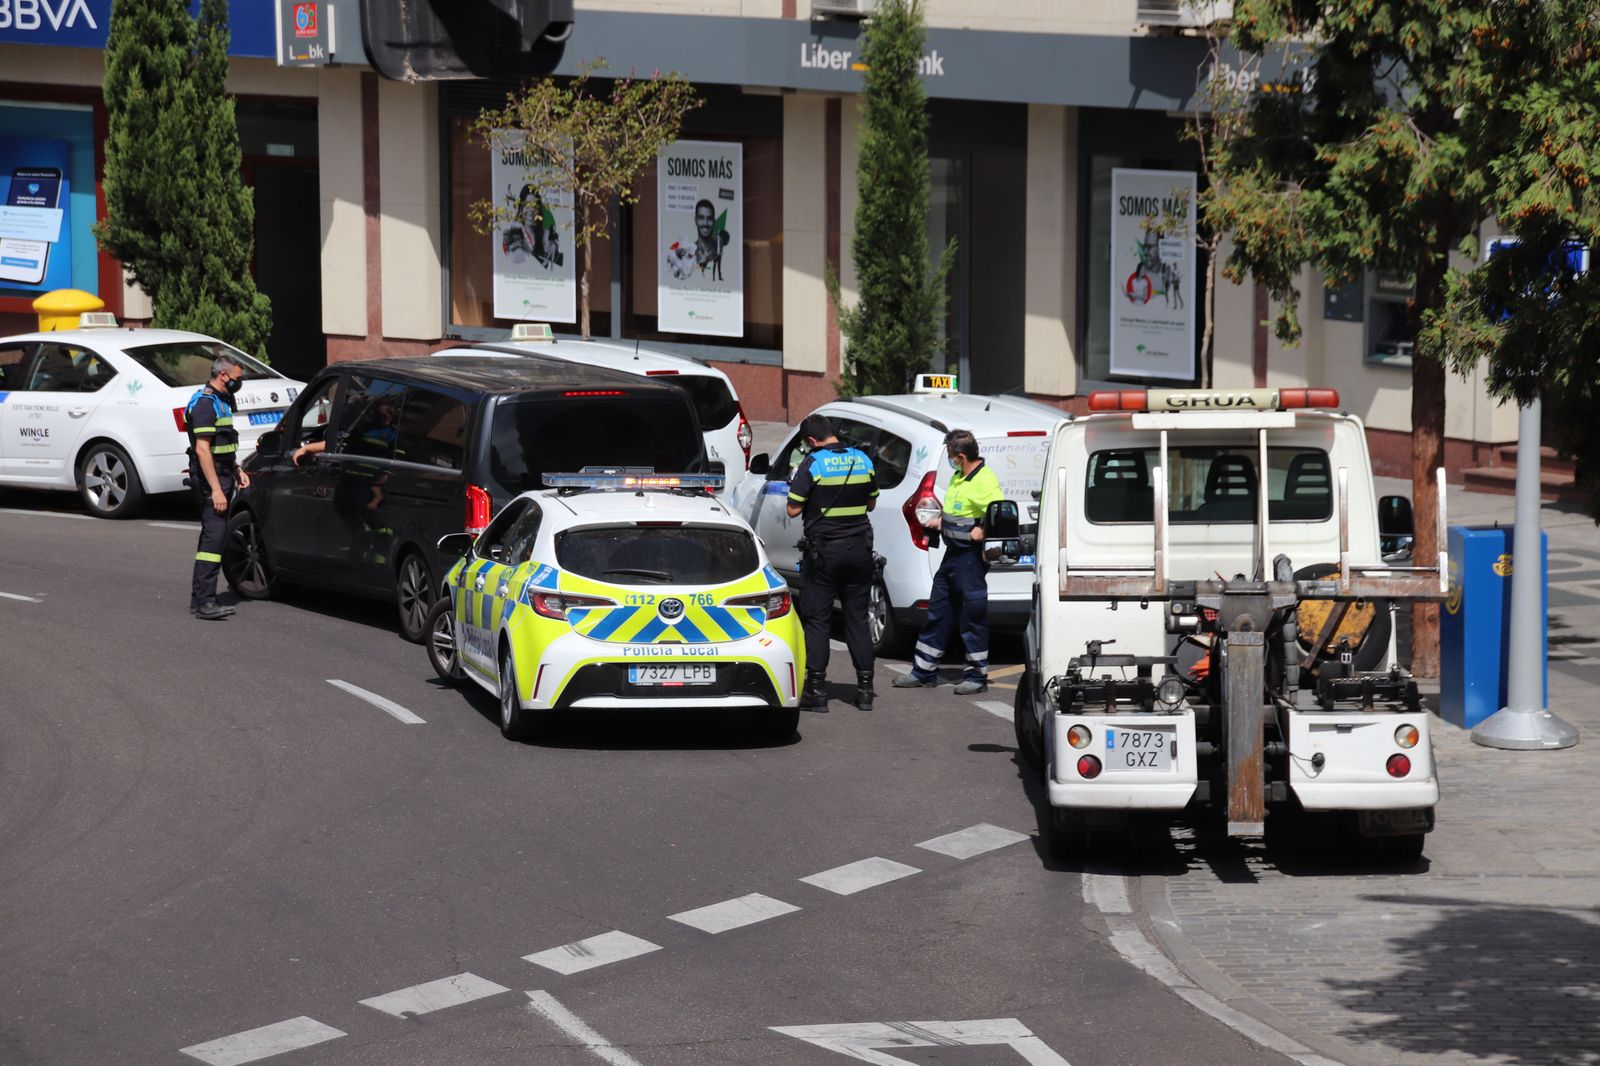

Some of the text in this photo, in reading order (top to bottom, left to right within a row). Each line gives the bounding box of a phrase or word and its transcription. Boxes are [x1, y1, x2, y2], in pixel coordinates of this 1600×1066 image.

[801, 43, 852, 70] Liber
[667, 155, 733, 179] SOMOS MÁS
[1119, 195, 1159, 217] SOMOS
[930, 376, 951, 388] TAXI
[1166, 393, 1256, 407] GRUA
[630, 594, 714, 606] 112 766
[681, 647, 719, 656] Local
[640, 666, 712, 680] 7327 LPB
[1121, 733, 1164, 748] 7873
[1126, 752, 1158, 767] GXZ
